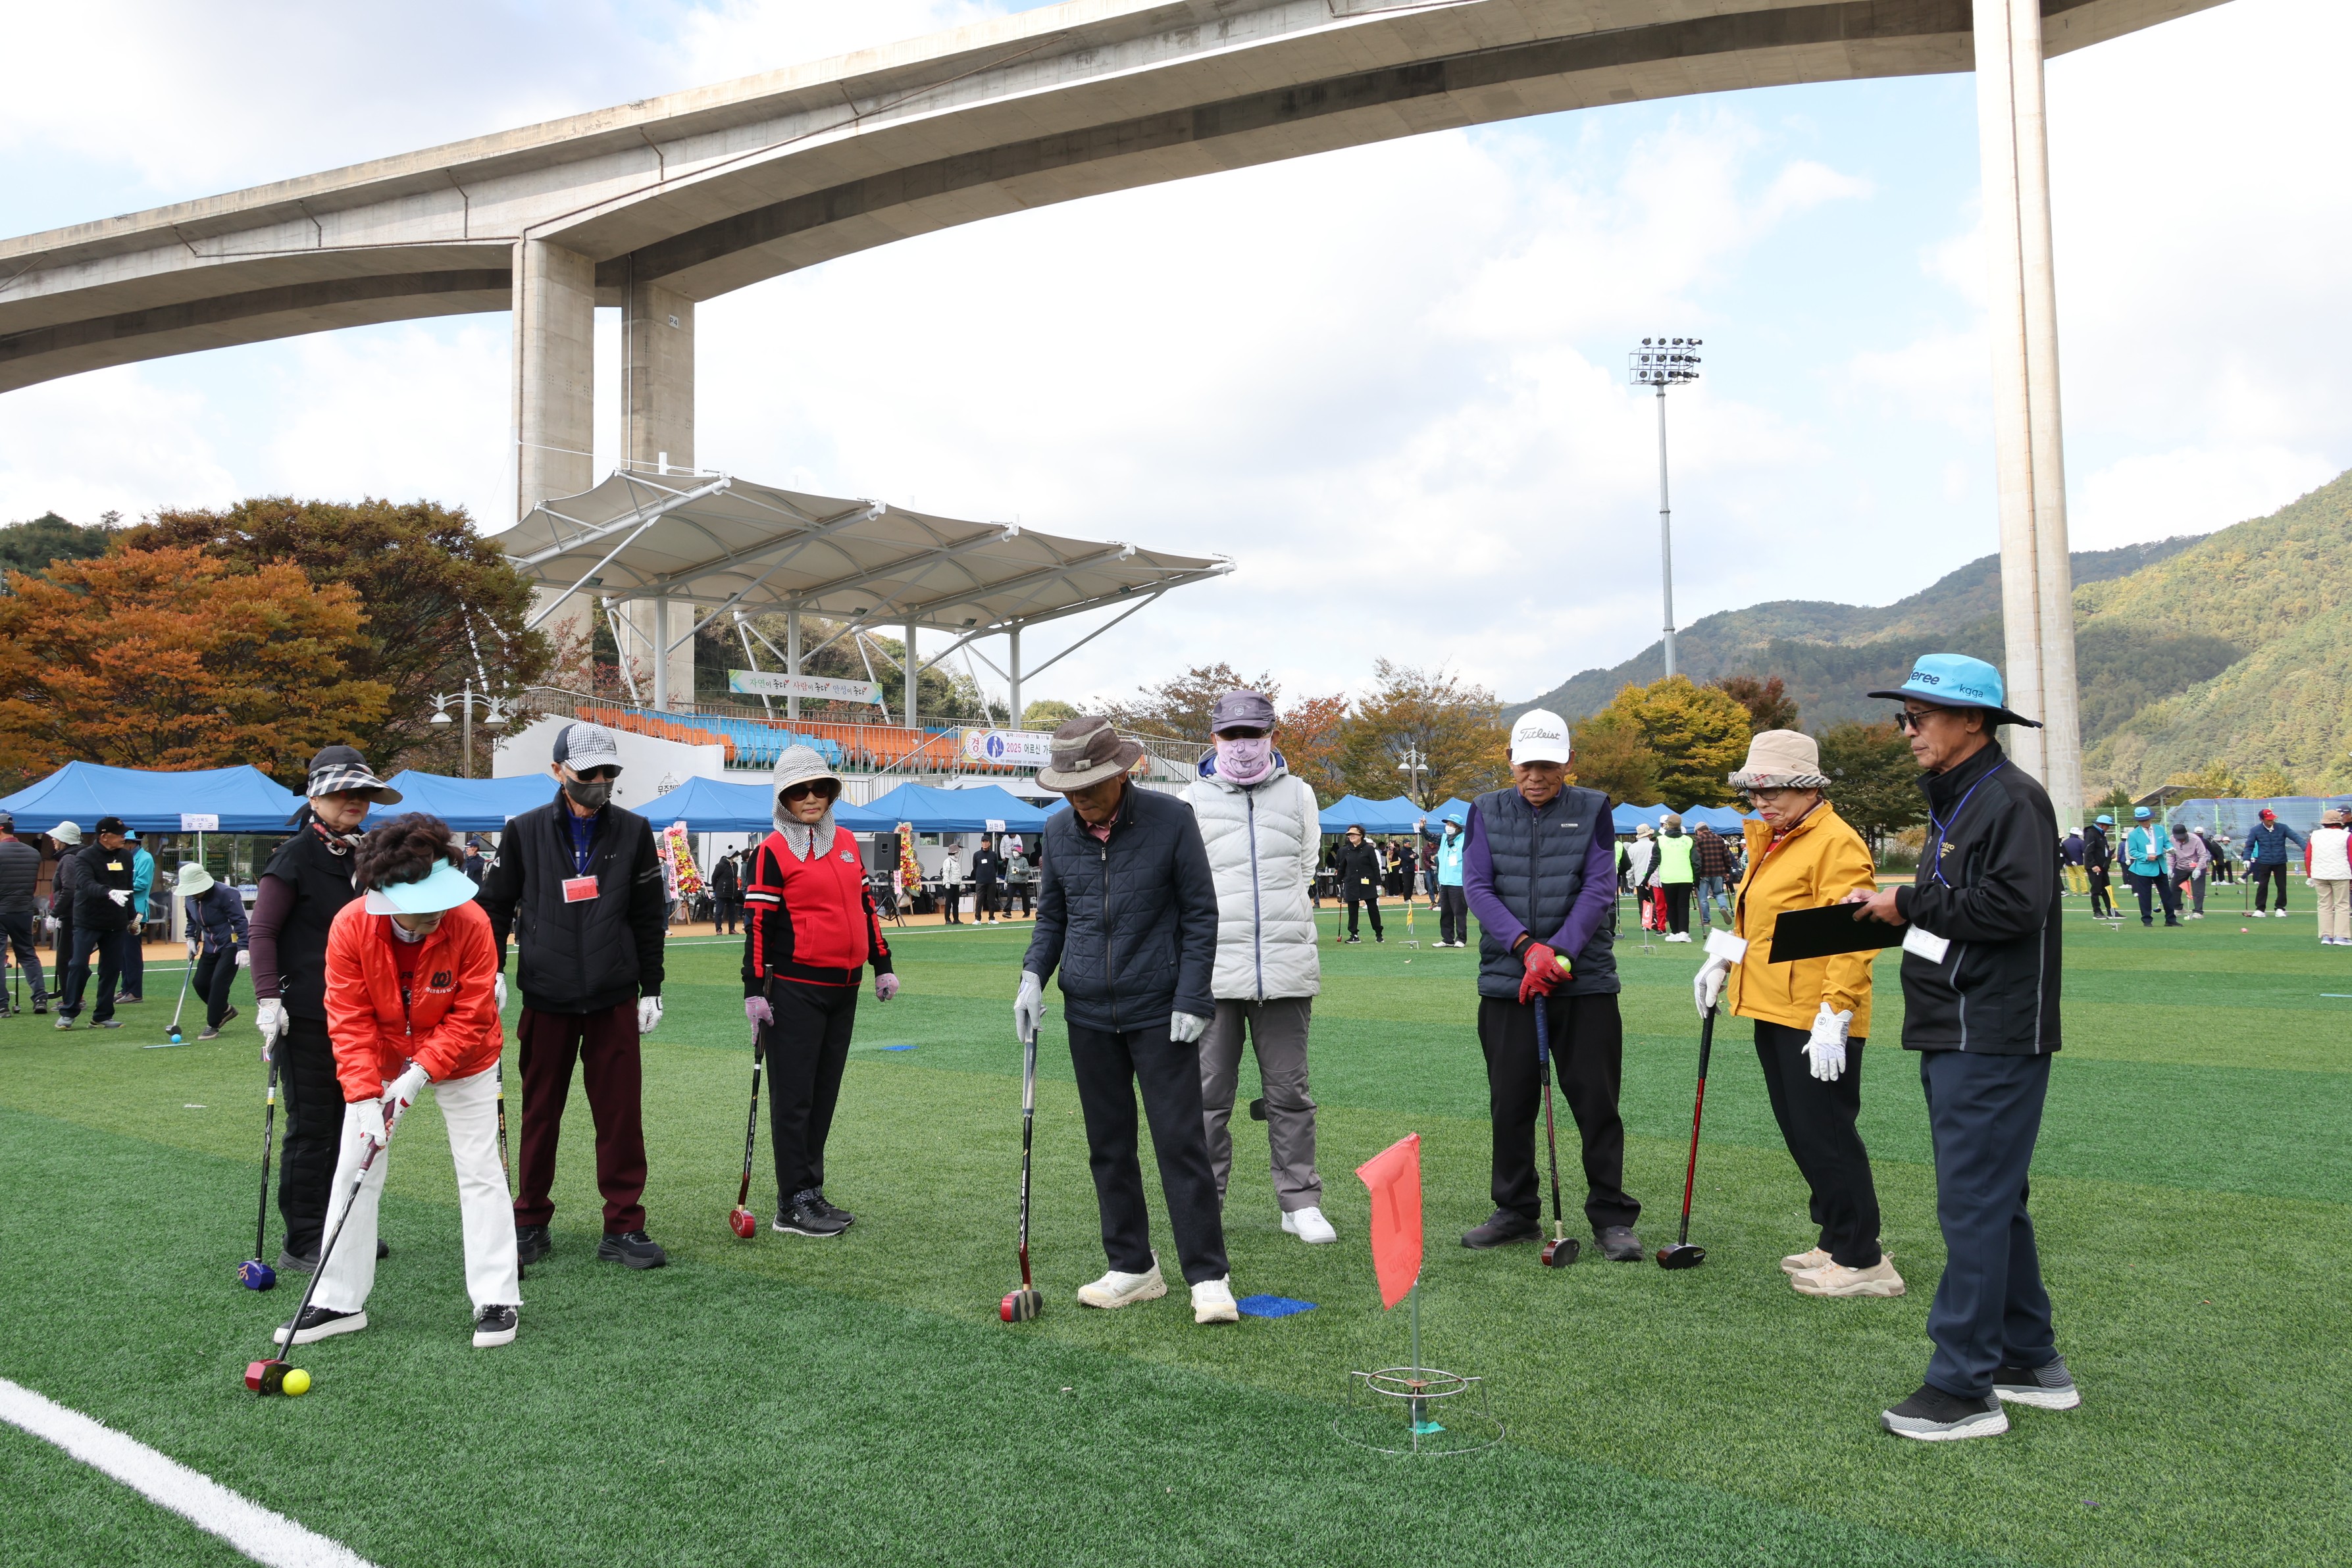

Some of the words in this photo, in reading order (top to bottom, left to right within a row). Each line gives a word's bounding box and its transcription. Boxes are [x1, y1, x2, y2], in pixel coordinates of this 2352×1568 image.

[750, 677, 771, 689] 자연이
[773, 678, 786, 690] 좋다
[793, 681, 814, 692] 사람이
[815, 682, 828, 692] 좋다
[832, 684, 852, 695] 안성이
[853, 686, 865, 696] 좋다
[1959, 683, 1983, 698] kgga
[1518, 726, 1561, 742] Titleist
[971, 737, 980, 753] 경
[1006, 742, 1022, 753] 2025
[1024, 743, 1040, 755] 어르신
[1941, 842, 1955, 850] itro
[1644, 904, 1650, 918] 8
